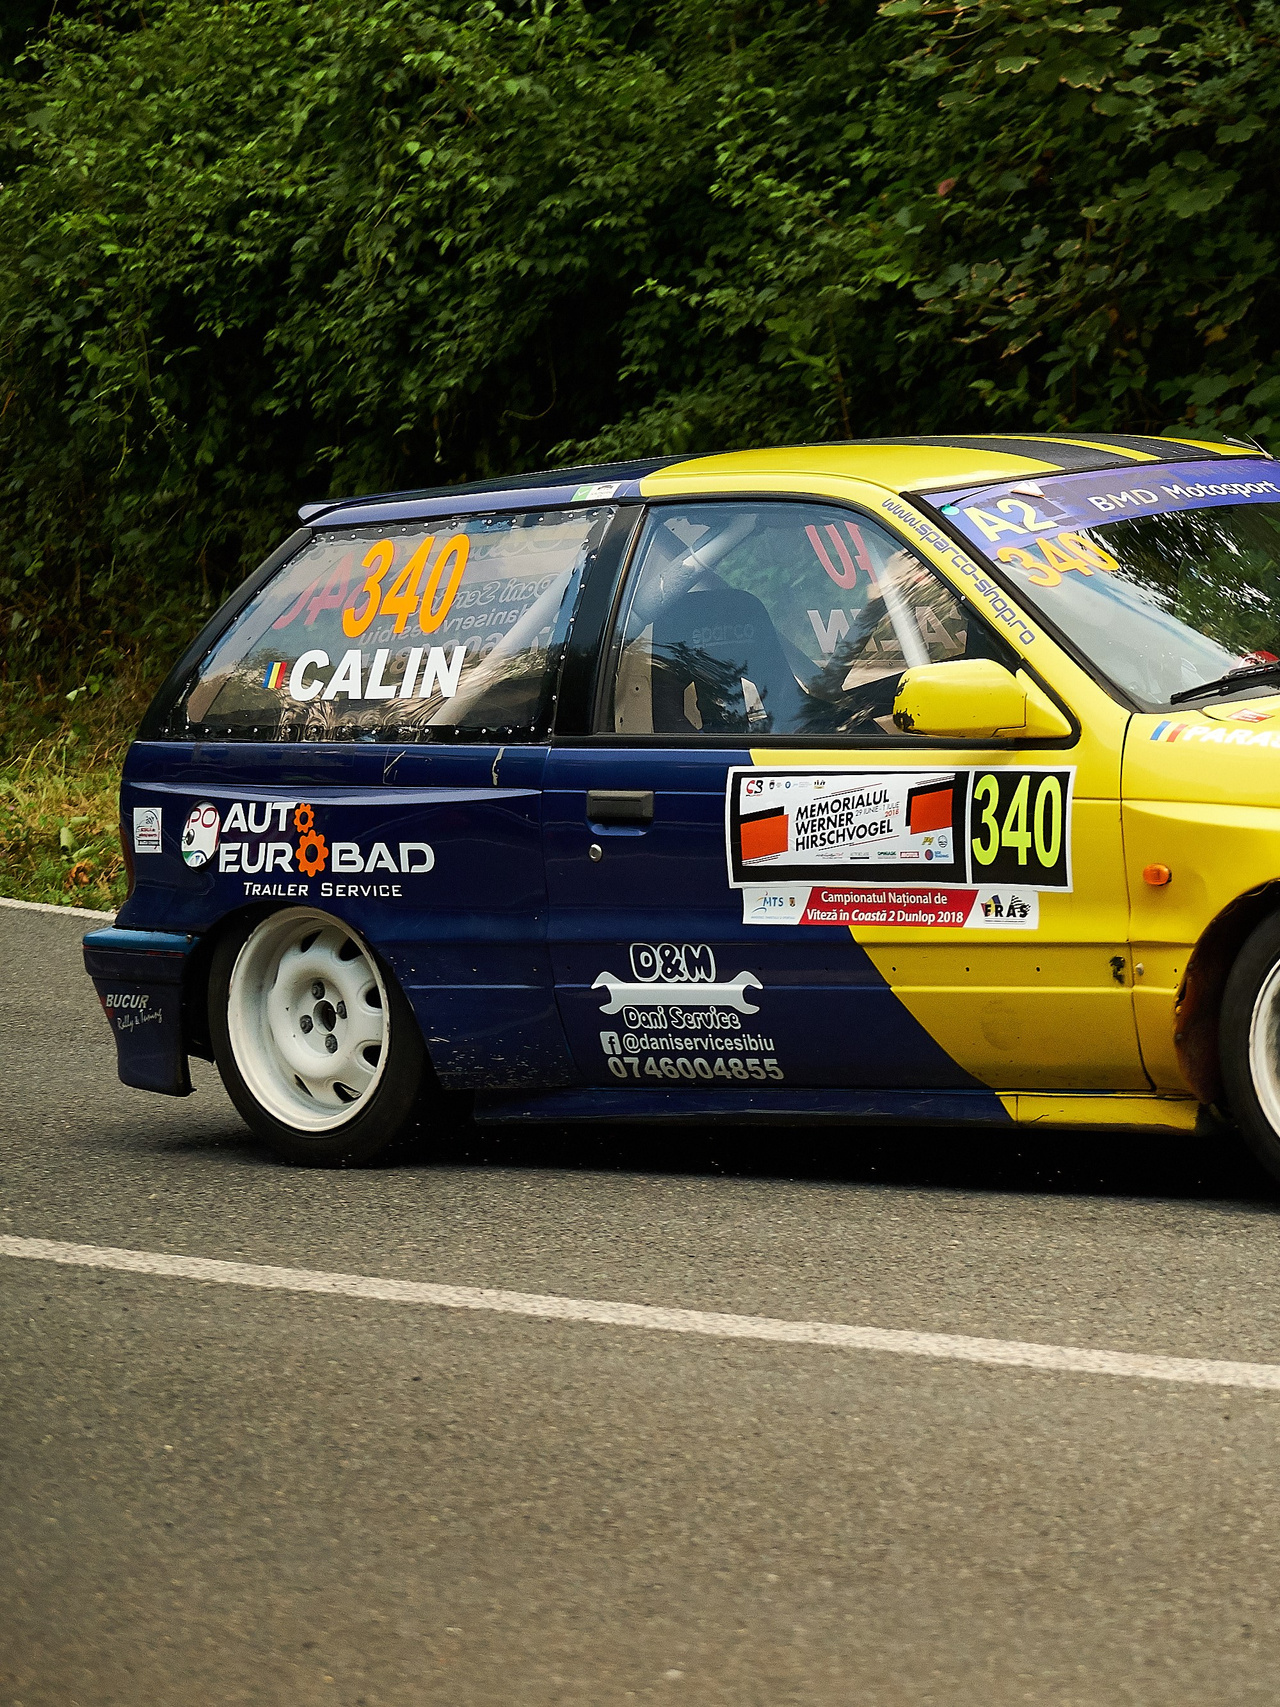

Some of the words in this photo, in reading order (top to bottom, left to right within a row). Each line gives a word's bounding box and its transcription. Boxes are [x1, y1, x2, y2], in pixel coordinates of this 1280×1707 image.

[1087, 488, 1158, 512] BMD
[963, 498, 1059, 542] A2
[881, 497, 1036, 645] www.sparco-shop.ro
[997, 532, 1120, 587] 340
[342, 533, 471, 637] 340
[289, 645, 467, 701] CALIN
[796, 789, 889, 821] MEMORIALUL
[795, 818, 893, 851] HIRSCHVOGEL
[796, 811, 854, 835] WERNER
[972, 774, 1062, 868] 340
[762, 896, 784, 907] MTS
[820, 890, 887, 906] Campionatul
[888, 892, 932, 907] Național
[933, 894, 948, 905] de
[806, 908, 838, 921] Viteză
[839, 908, 850, 920] în
[851, 908, 887, 922] Coastă
[887, 910, 895, 921] 2
[896, 910, 936, 925] Dunlop
[937, 911, 964, 923] 2018
[629, 942, 717, 983] D&M
[105, 994, 149, 1009] BUCUR
[622, 1005, 668, 1030] Dani
[668, 1005, 742, 1030] Service
[622, 1032, 775, 1054] @daniservicesibiu
[607, 1056, 785, 1080] 0746004855
